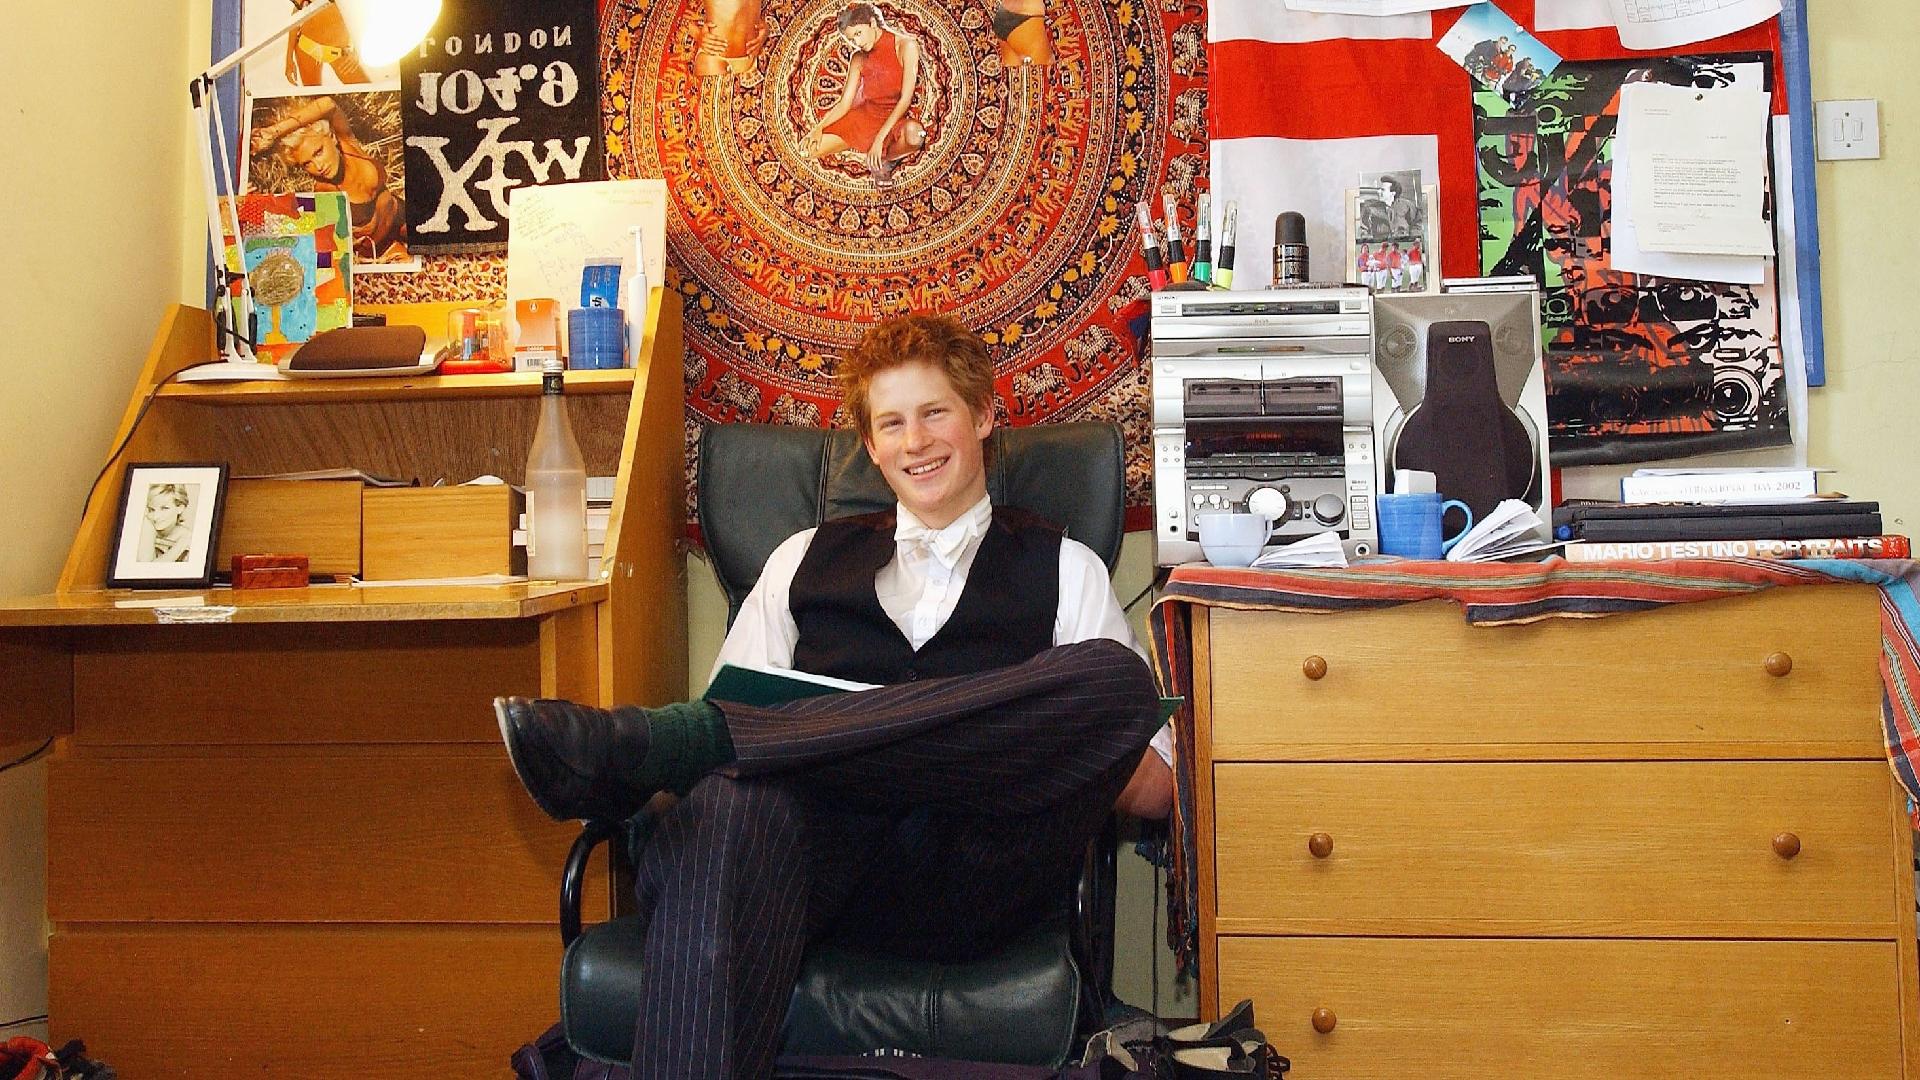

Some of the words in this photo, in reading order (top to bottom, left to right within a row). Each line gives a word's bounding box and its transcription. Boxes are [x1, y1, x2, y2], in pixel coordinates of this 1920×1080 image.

[1775, 481, 1801, 491] 2002
[1583, 543, 1653, 561] MARIO
[1653, 540, 1749, 560] TESTINO
[1755, 538, 1884, 556] PORTRAITS
